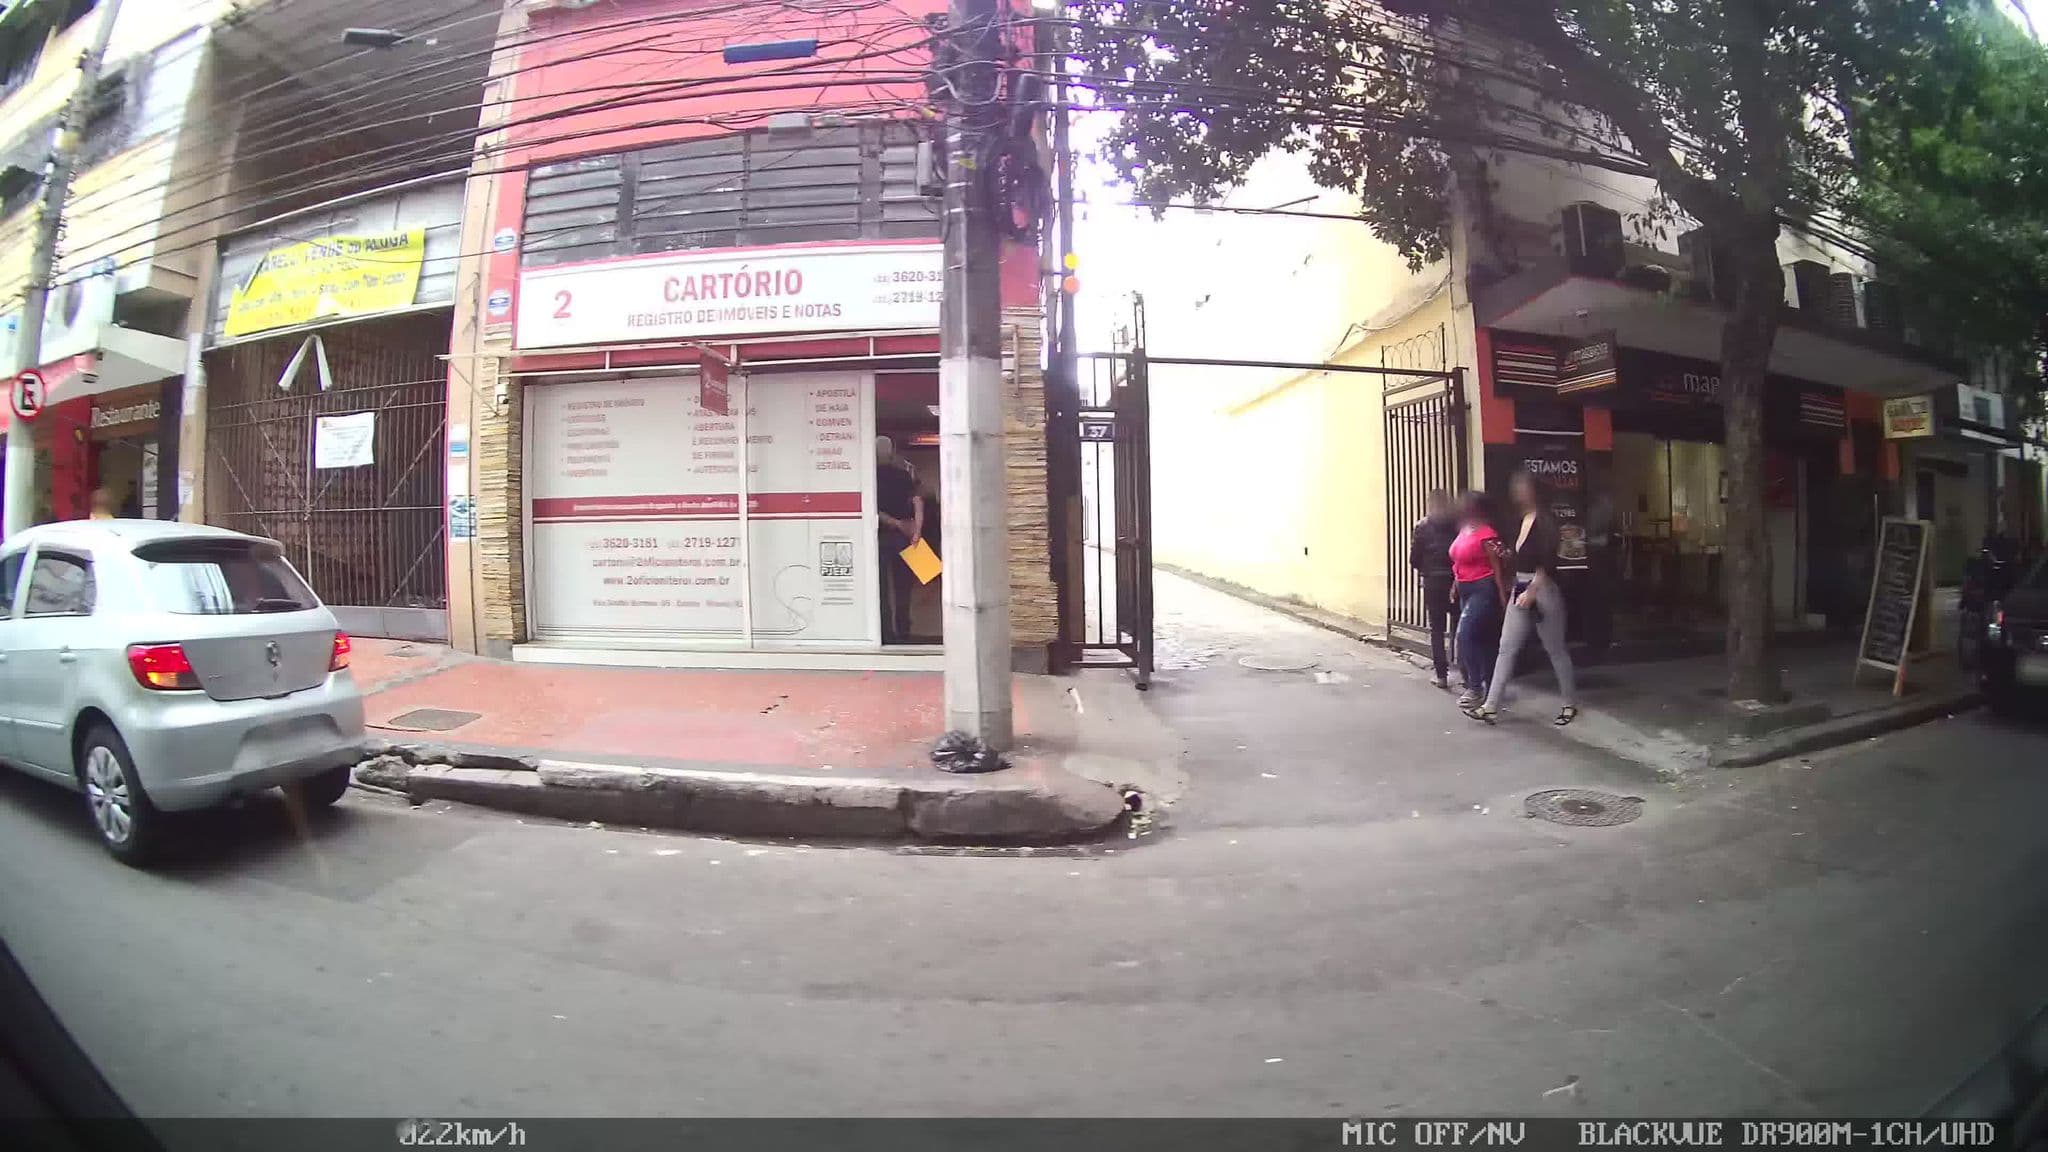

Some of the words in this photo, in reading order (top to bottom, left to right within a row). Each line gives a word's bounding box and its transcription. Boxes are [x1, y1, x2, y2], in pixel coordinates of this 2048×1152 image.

[664, 265, 803, 302] CARTÓRIO
[892, 270, 944, 282] 3620-31
[553, 290, 573, 319] 2
[627, 310, 693, 328] REGISTRO
[696, 308, 714, 323] DE
[782, 304, 791, 319] E
[795, 303, 842, 318] NOTAS
[90, 400, 160, 429] Restaurante
[1087, 425, 1108, 438] 37
[1524, 459, 1577, 474] ESTAMOS
